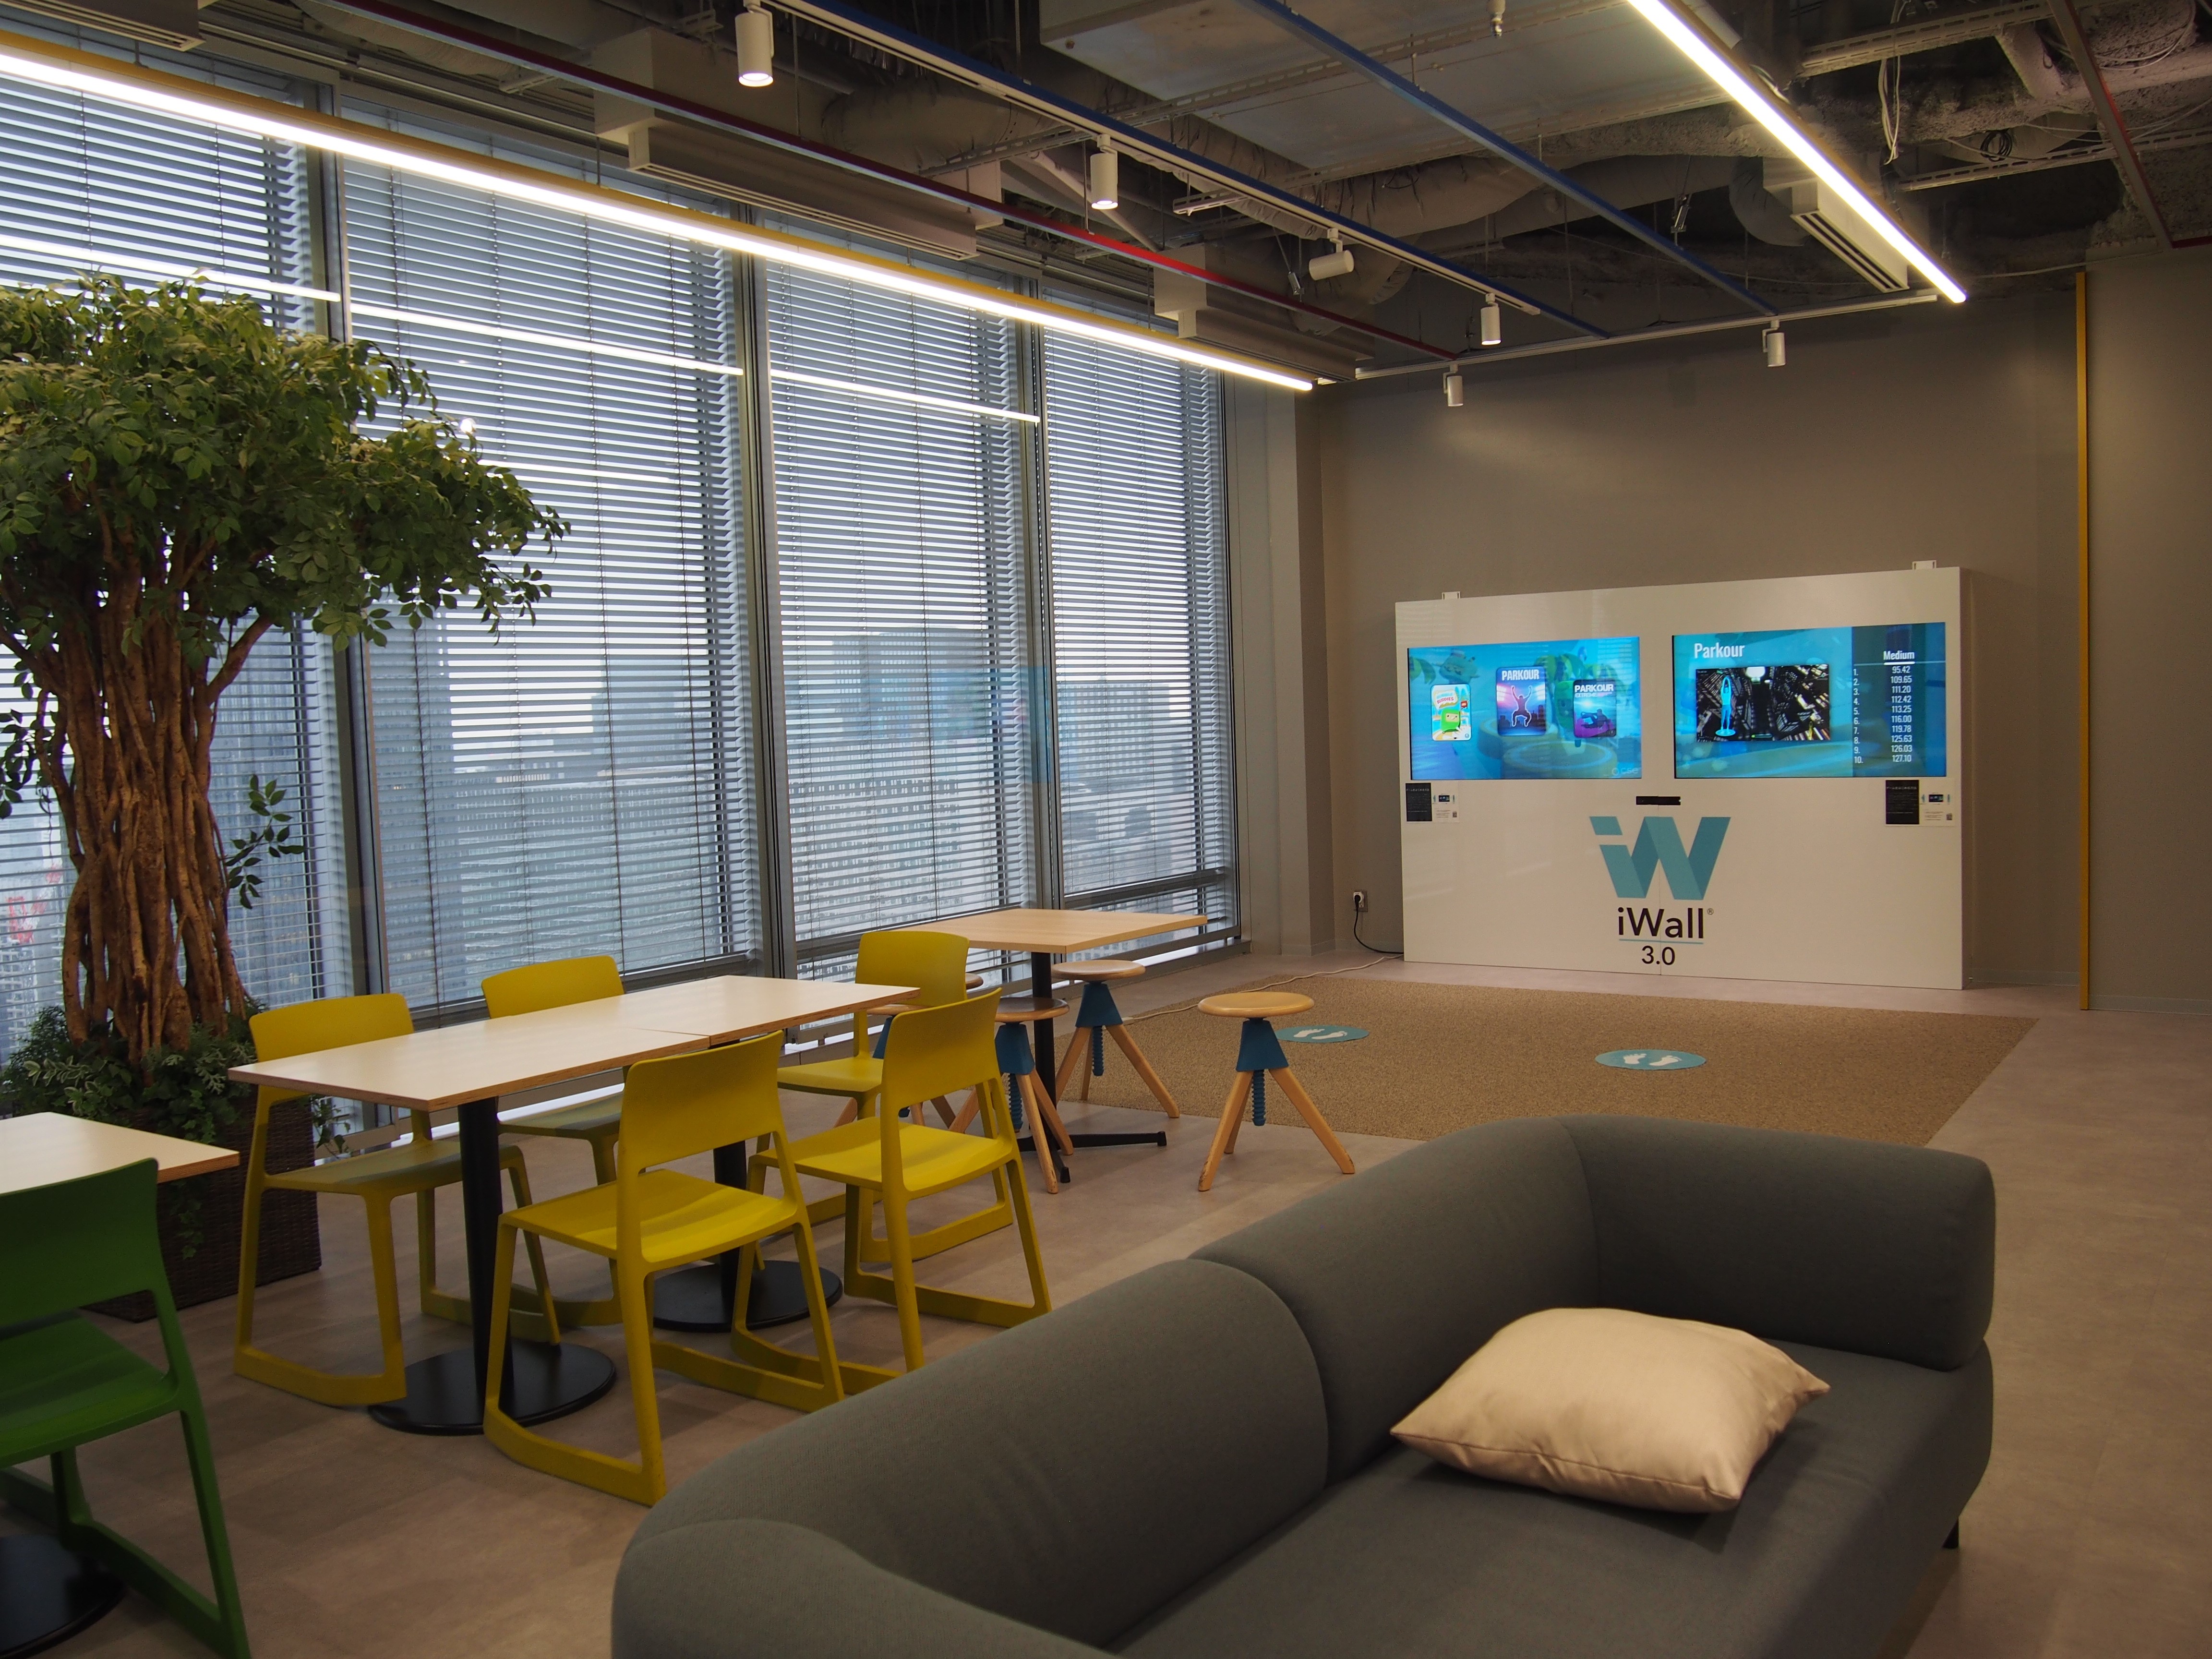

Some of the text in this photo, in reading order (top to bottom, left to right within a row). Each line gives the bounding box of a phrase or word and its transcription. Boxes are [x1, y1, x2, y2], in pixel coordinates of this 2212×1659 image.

[1694, 642, 1745, 659] Parkour
[1883, 650, 1914, 661] Medium
[1892, 665, 1911, 673] 95.42
[1502, 669, 1539, 681] PARKOUR
[1890, 675, 1912, 684] 109.65
[1575, 684, 1613, 693] PARKOUR
[1891, 695, 1911, 703] 112.42
[1891, 715, 1912, 723] 116.00
[1892, 754, 1912, 762] 127.10
[1641, 945, 1675, 966] 3.0
